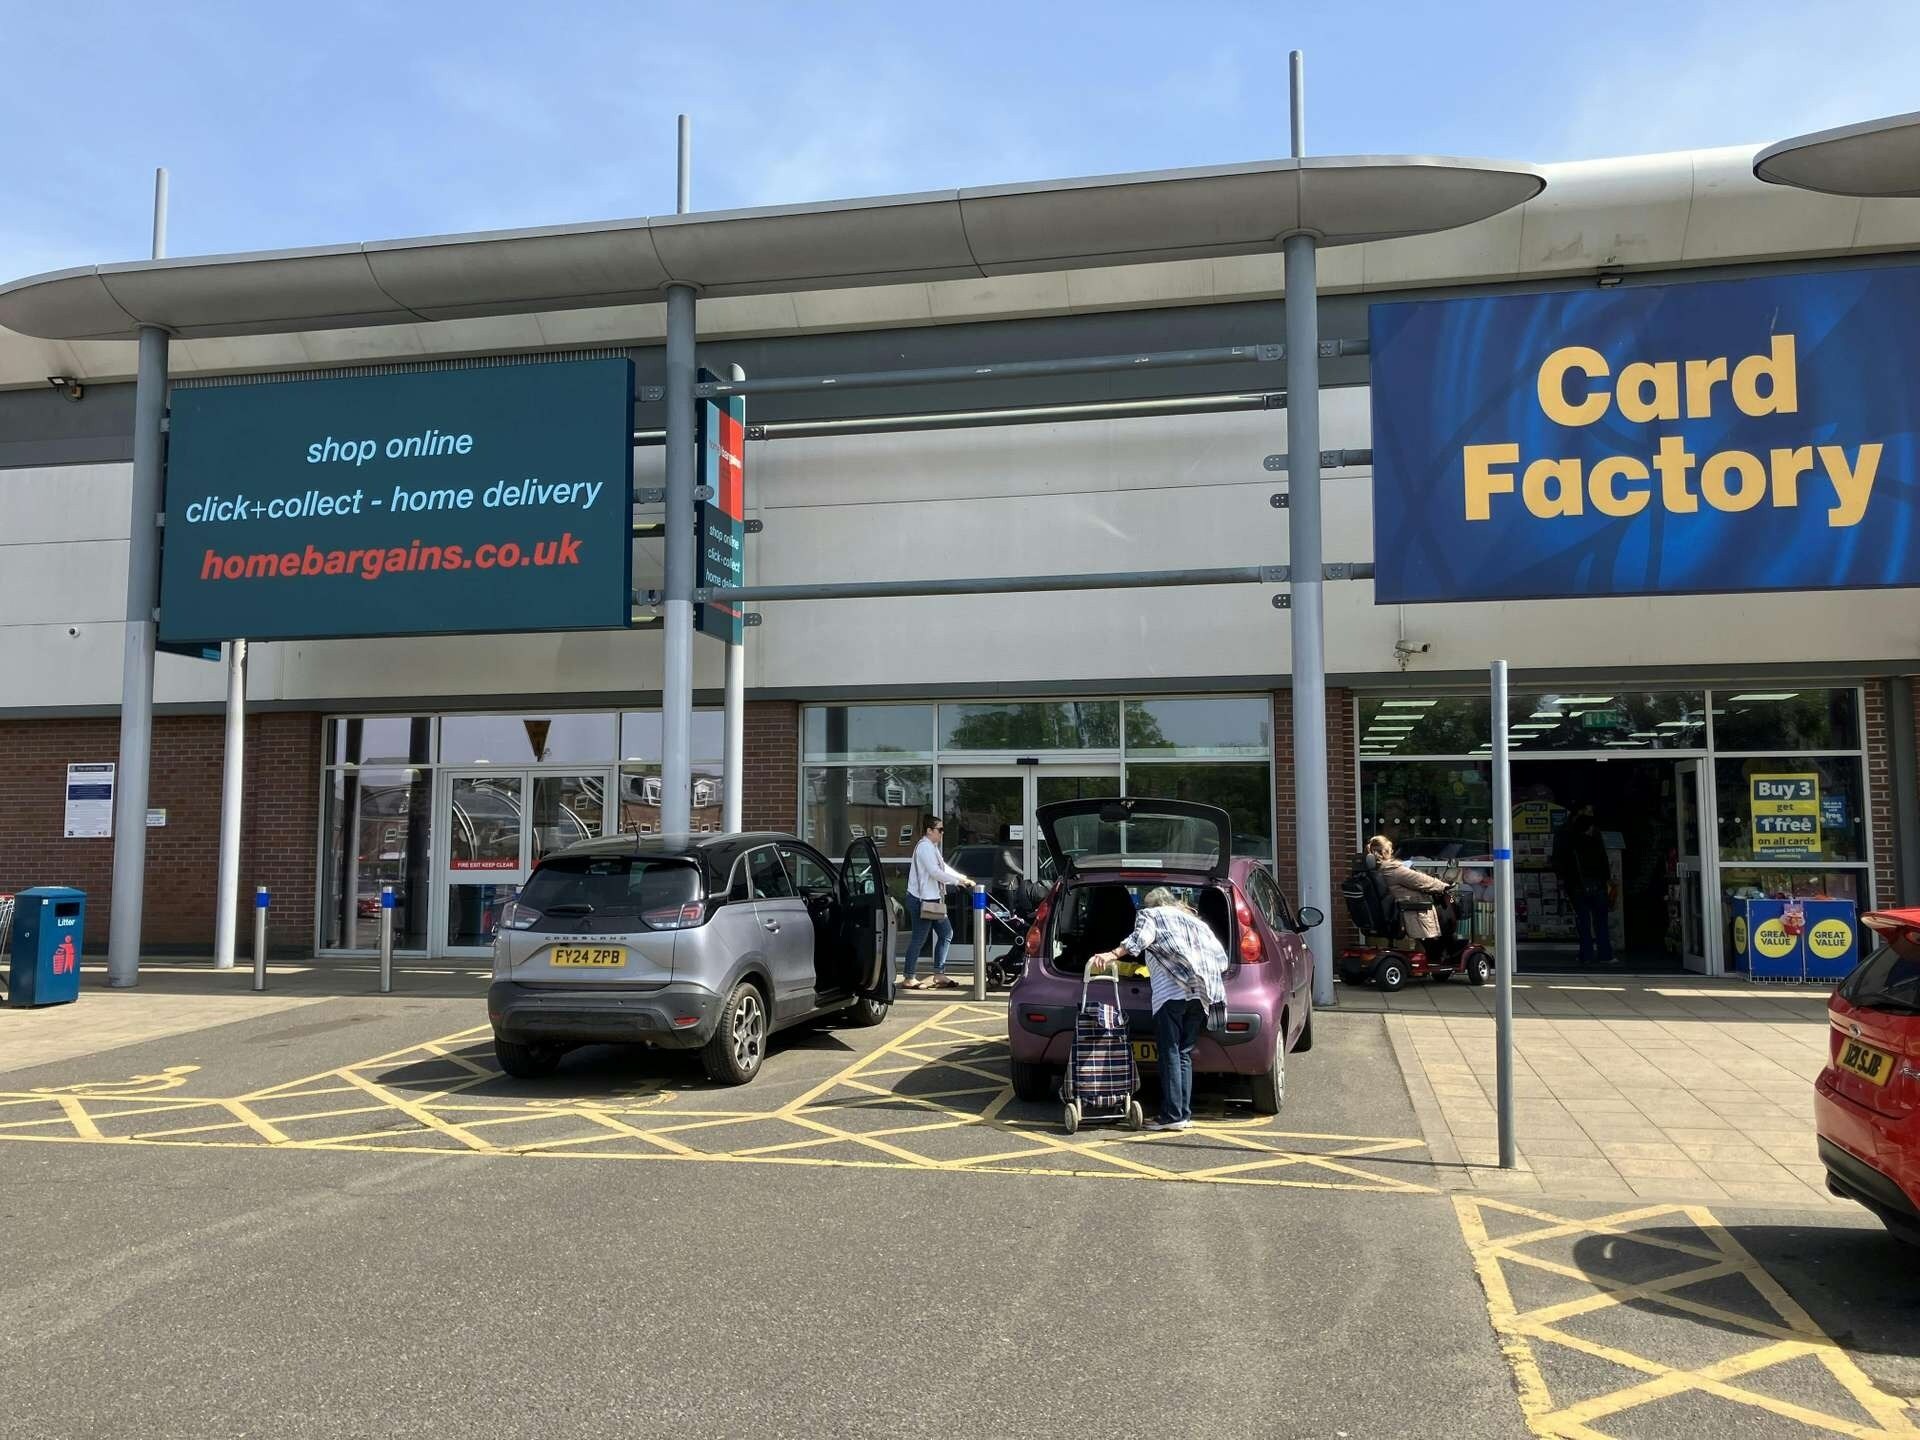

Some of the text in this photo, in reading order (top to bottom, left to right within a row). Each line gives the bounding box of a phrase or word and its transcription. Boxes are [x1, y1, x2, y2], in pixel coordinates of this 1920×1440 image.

[1537, 334, 1798, 427] Card
[306, 430, 474, 466] shop online
[1463, 436, 1884, 528] Factory
[185, 489, 363, 523] click+collect
[390, 486, 474, 513] home
[482, 479, 603, 509] delivery
[709, 525, 739, 550] shop online
[200, 533, 584, 580] homebargains.co.uk
[706, 567, 721, 586] home
[1758, 781, 1811, 800] Buy 3
[1776, 803, 1794, 813] get
[1761, 817, 1812, 832] 1 free
[1773, 837, 1786, 845] all
[1788, 837, 1816, 846] cards
[1761, 938, 1791, 946] VALUE
[1814, 931, 1846, 939] GREAT
[1815, 939, 1847, 947] VALUE
[555, 949, 620, 964] FY24 ZPB
